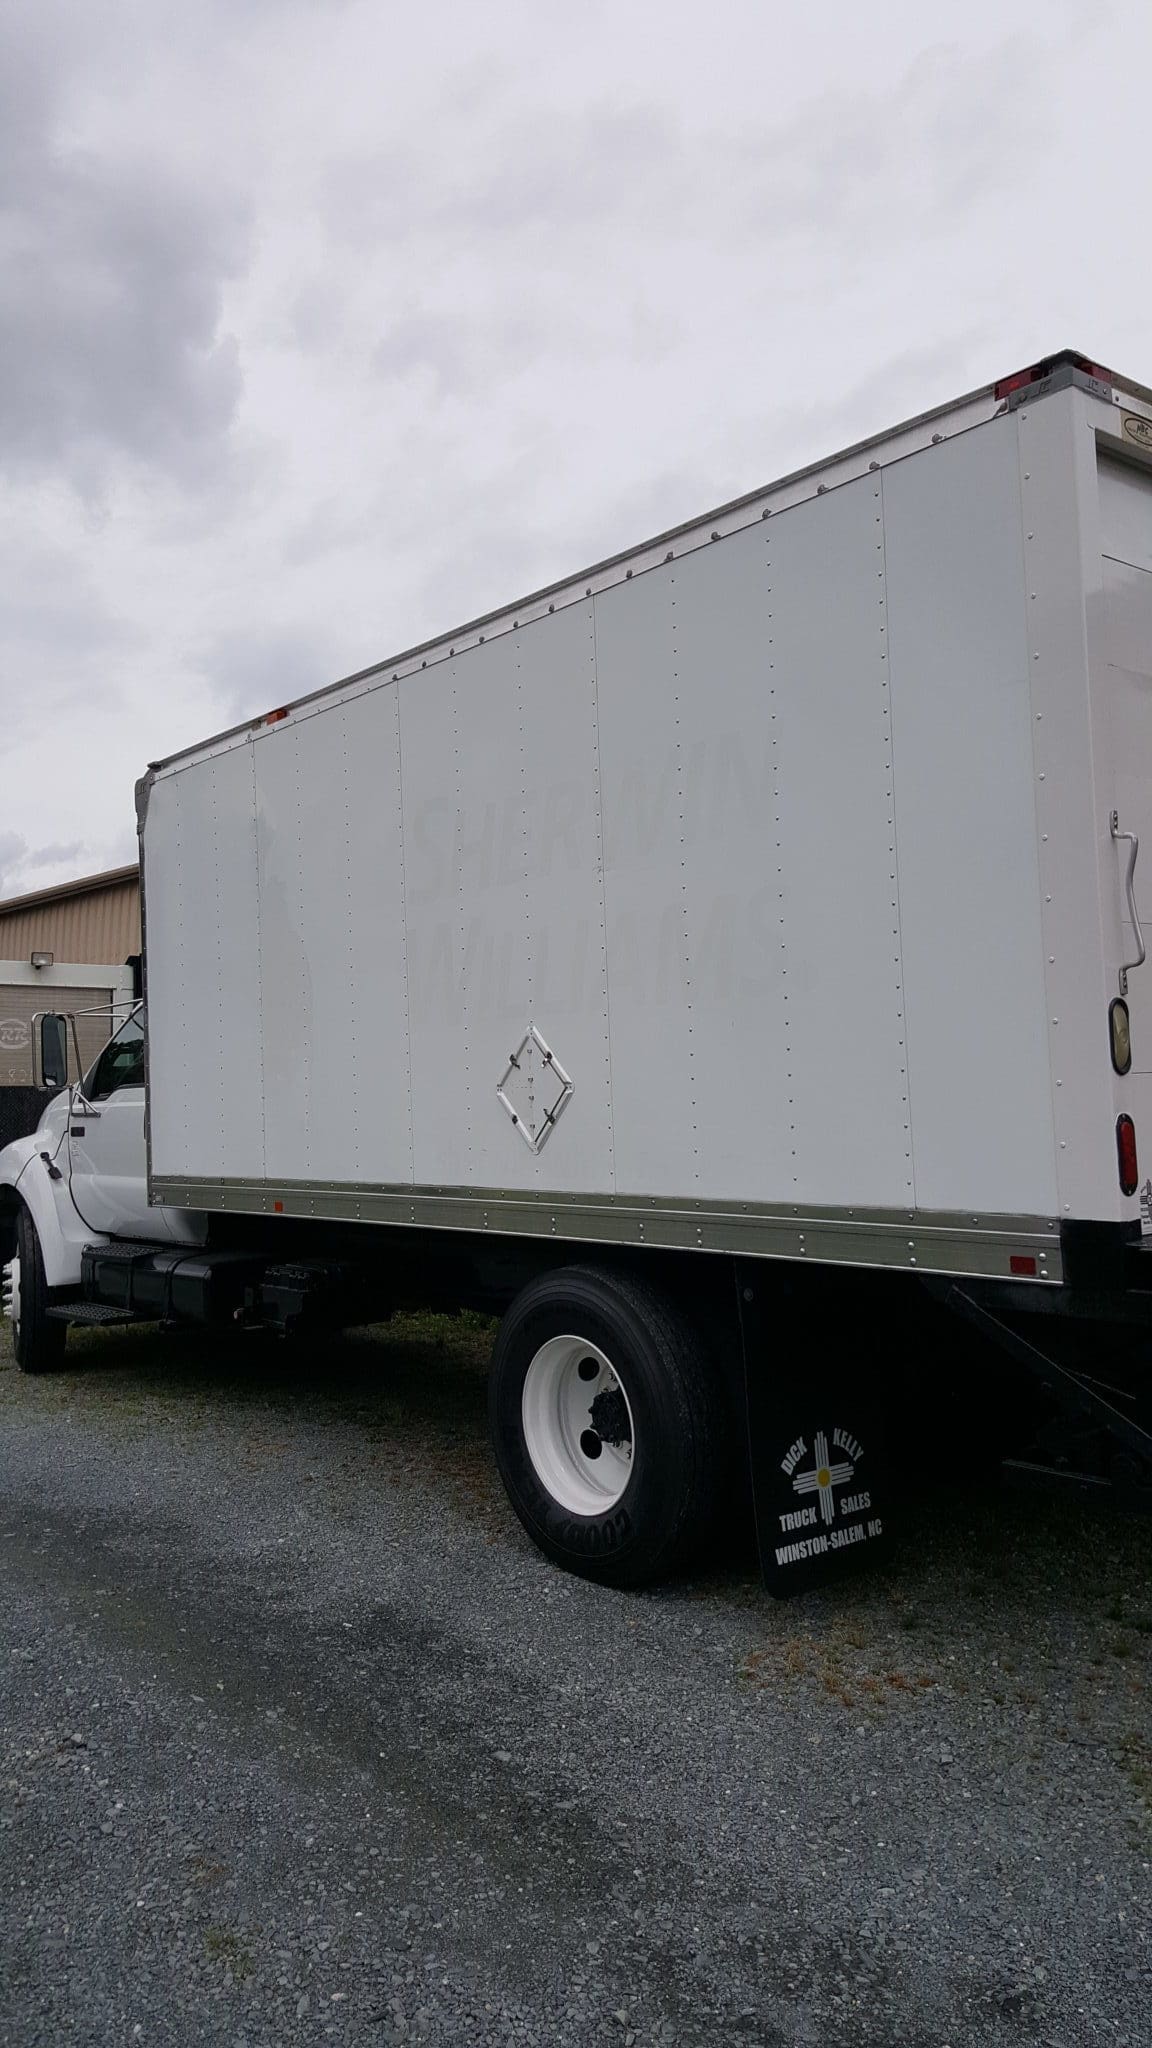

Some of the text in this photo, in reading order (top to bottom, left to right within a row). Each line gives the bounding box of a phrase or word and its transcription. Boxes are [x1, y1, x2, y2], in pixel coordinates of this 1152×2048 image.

[780, 1428, 864, 1475] DICK KELLY
[779, 1492, 871, 1531] TRUCK SALES
[775, 1519, 882, 1566] WINSTON-SALEM, NC
